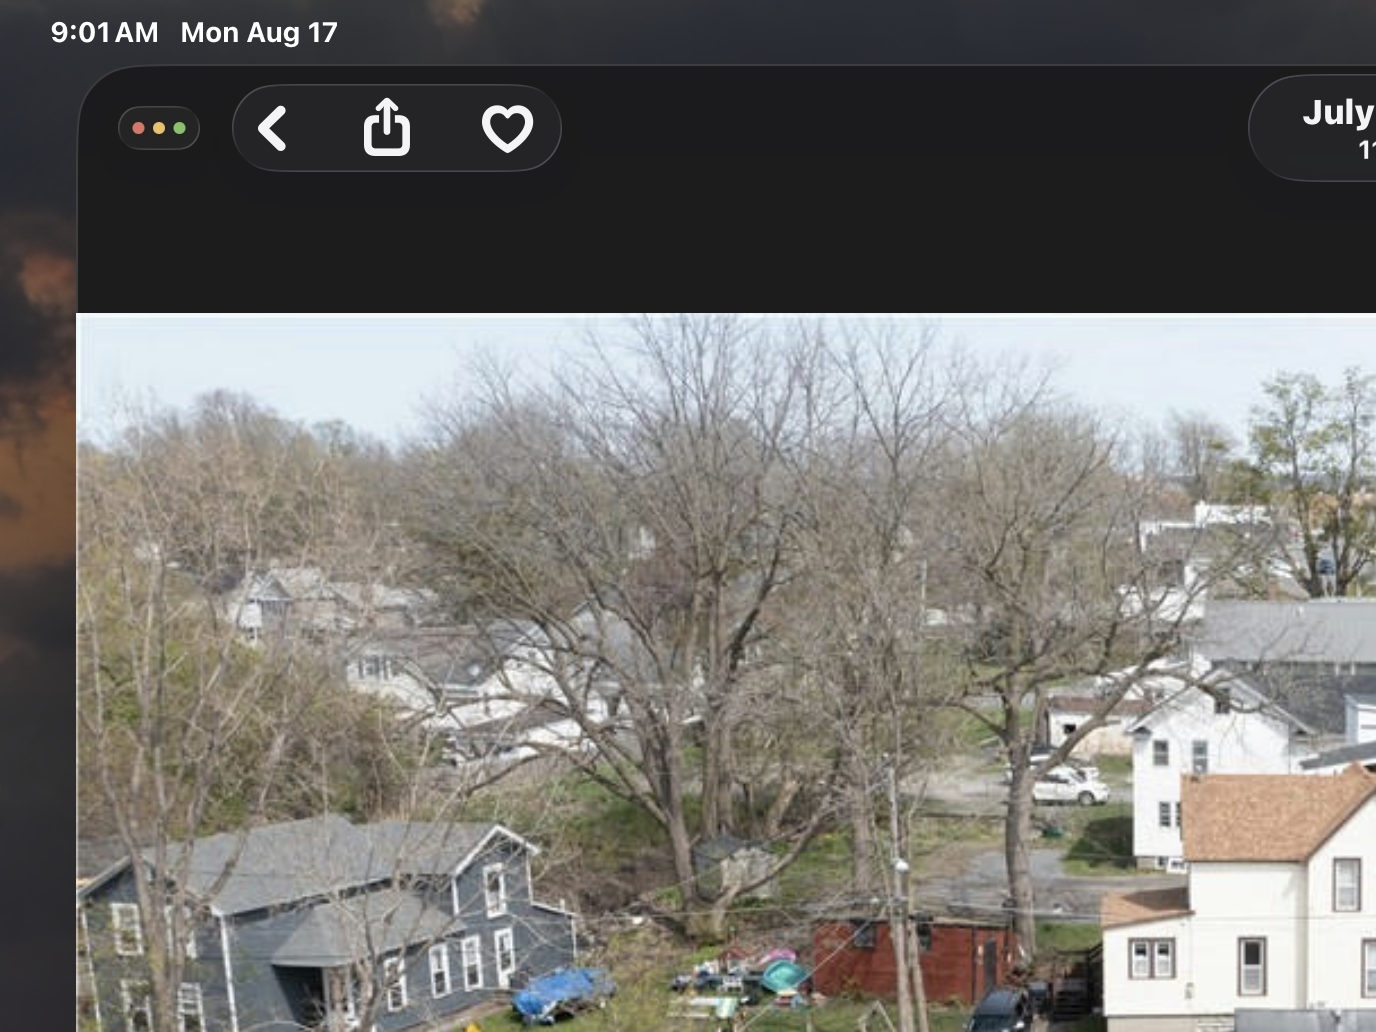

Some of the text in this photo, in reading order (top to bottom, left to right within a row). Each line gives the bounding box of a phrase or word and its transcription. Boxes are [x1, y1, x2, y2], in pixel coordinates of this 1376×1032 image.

[51, 21, 338, 48] 9:01 AM Mon Aug 17
[1302, 98, 1375, 131] July
